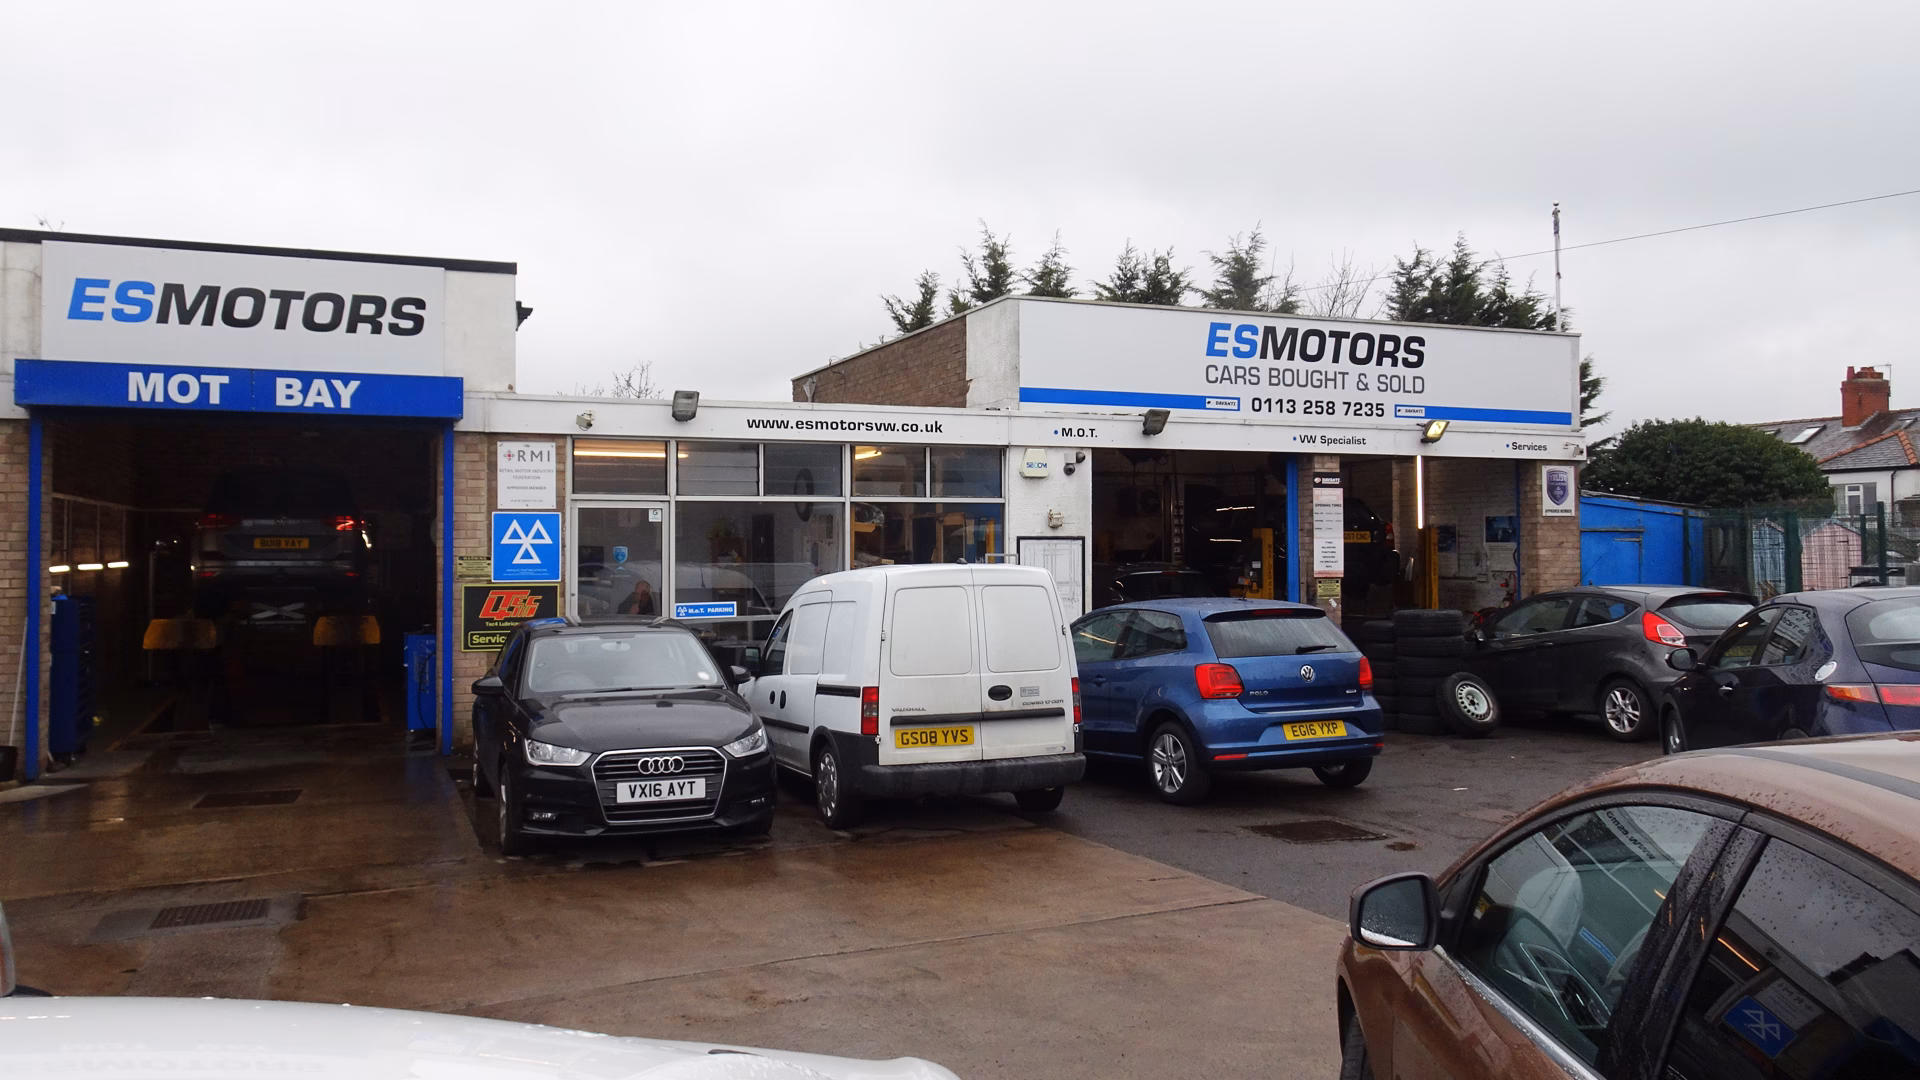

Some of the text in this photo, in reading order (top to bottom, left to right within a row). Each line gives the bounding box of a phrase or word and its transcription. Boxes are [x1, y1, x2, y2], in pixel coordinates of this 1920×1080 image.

[67, 277, 426, 336] ESMOTORS
[1205, 322, 1426, 368] ESMOTORS
[1205, 364, 1425, 394] CARS BOUGHT & SOLD
[127, 371, 361, 409] MOT BAY
[1251, 397, 1385, 418] 0113 258 7235
[746, 418, 944, 434] www.esmotorsvw.co.uk
[1061, 427, 1098, 438] M.O.T.
[1299, 434, 1367, 447] VW Specialist
[1511, 441, 1548, 452] Services
[517, 449, 550, 462] RMI
[472, 634, 507, 644] Servic
[900, 729, 969, 746] GS08 YVS
[1291, 722, 1338, 737] EG16 YXP
[628, 781, 696, 799] VX16 AYT
